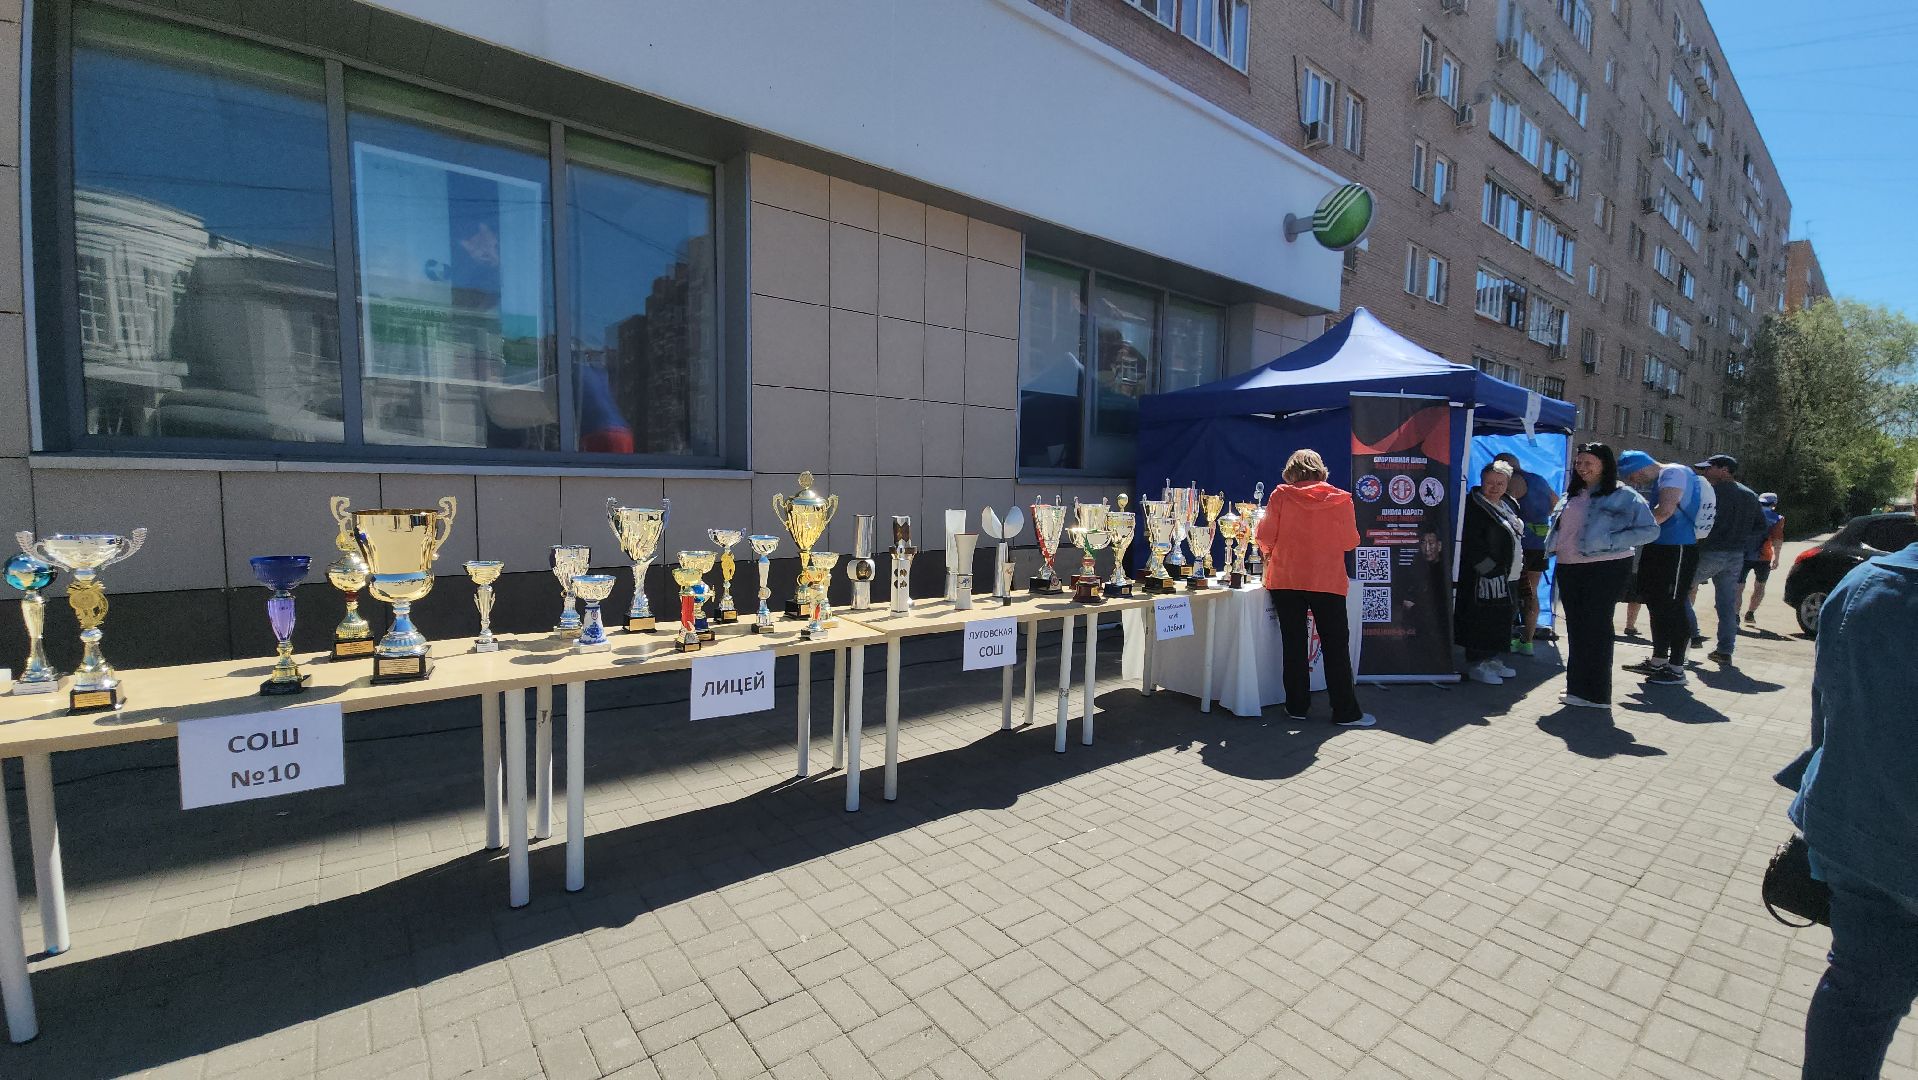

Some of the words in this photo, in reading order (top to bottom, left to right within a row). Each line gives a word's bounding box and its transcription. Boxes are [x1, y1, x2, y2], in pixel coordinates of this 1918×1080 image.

[968, 627, 1013, 640] ЛУГОВСКАЯ
[979, 644, 1003, 658] СОШ
[701, 670, 765, 697] ЛИЦЕЙ
[227, 727, 299, 753] СОШ
[231, 762, 301, 789] №10
